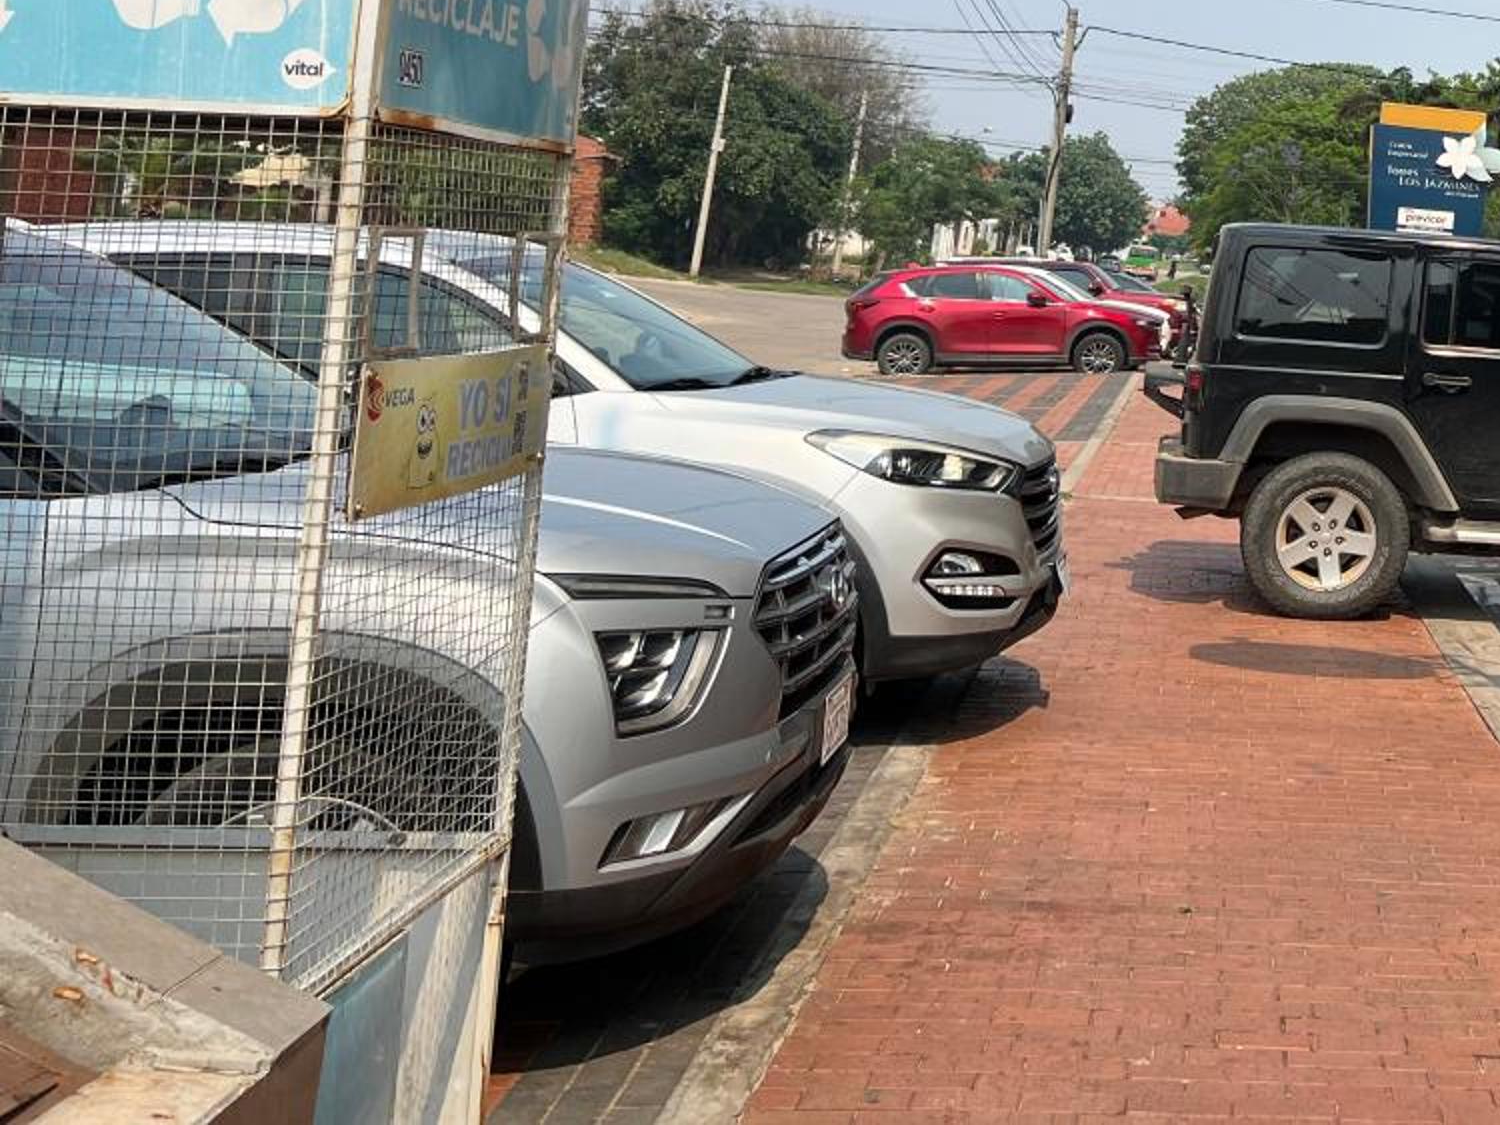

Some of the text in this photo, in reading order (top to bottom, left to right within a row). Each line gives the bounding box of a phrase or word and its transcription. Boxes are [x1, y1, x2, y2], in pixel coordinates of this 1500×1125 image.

[284, 59, 324, 77] vital
[1399, 176, 1421, 187] LOS
[384, 387, 416, 409] VEGA
[460, 379, 490, 431] YO
